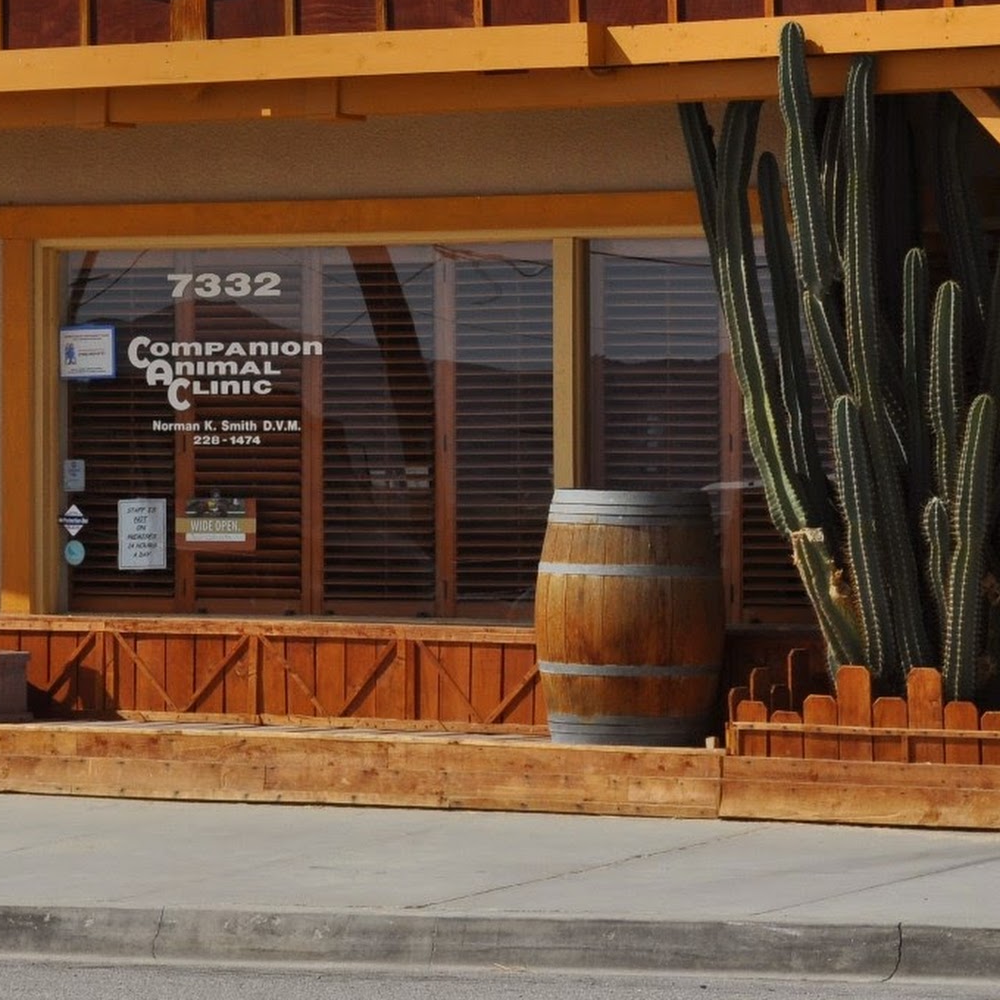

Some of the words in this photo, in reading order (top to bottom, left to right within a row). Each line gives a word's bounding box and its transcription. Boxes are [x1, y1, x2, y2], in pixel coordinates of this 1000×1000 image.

[167, 271, 282, 298] 7332
[152, 420, 200, 431] Norman
[204, 420, 217, 431] K.
[221, 420, 257, 431] Smith
[263, 420, 302, 431] D.V.M.
[190, 520, 213, 532] WIDE
